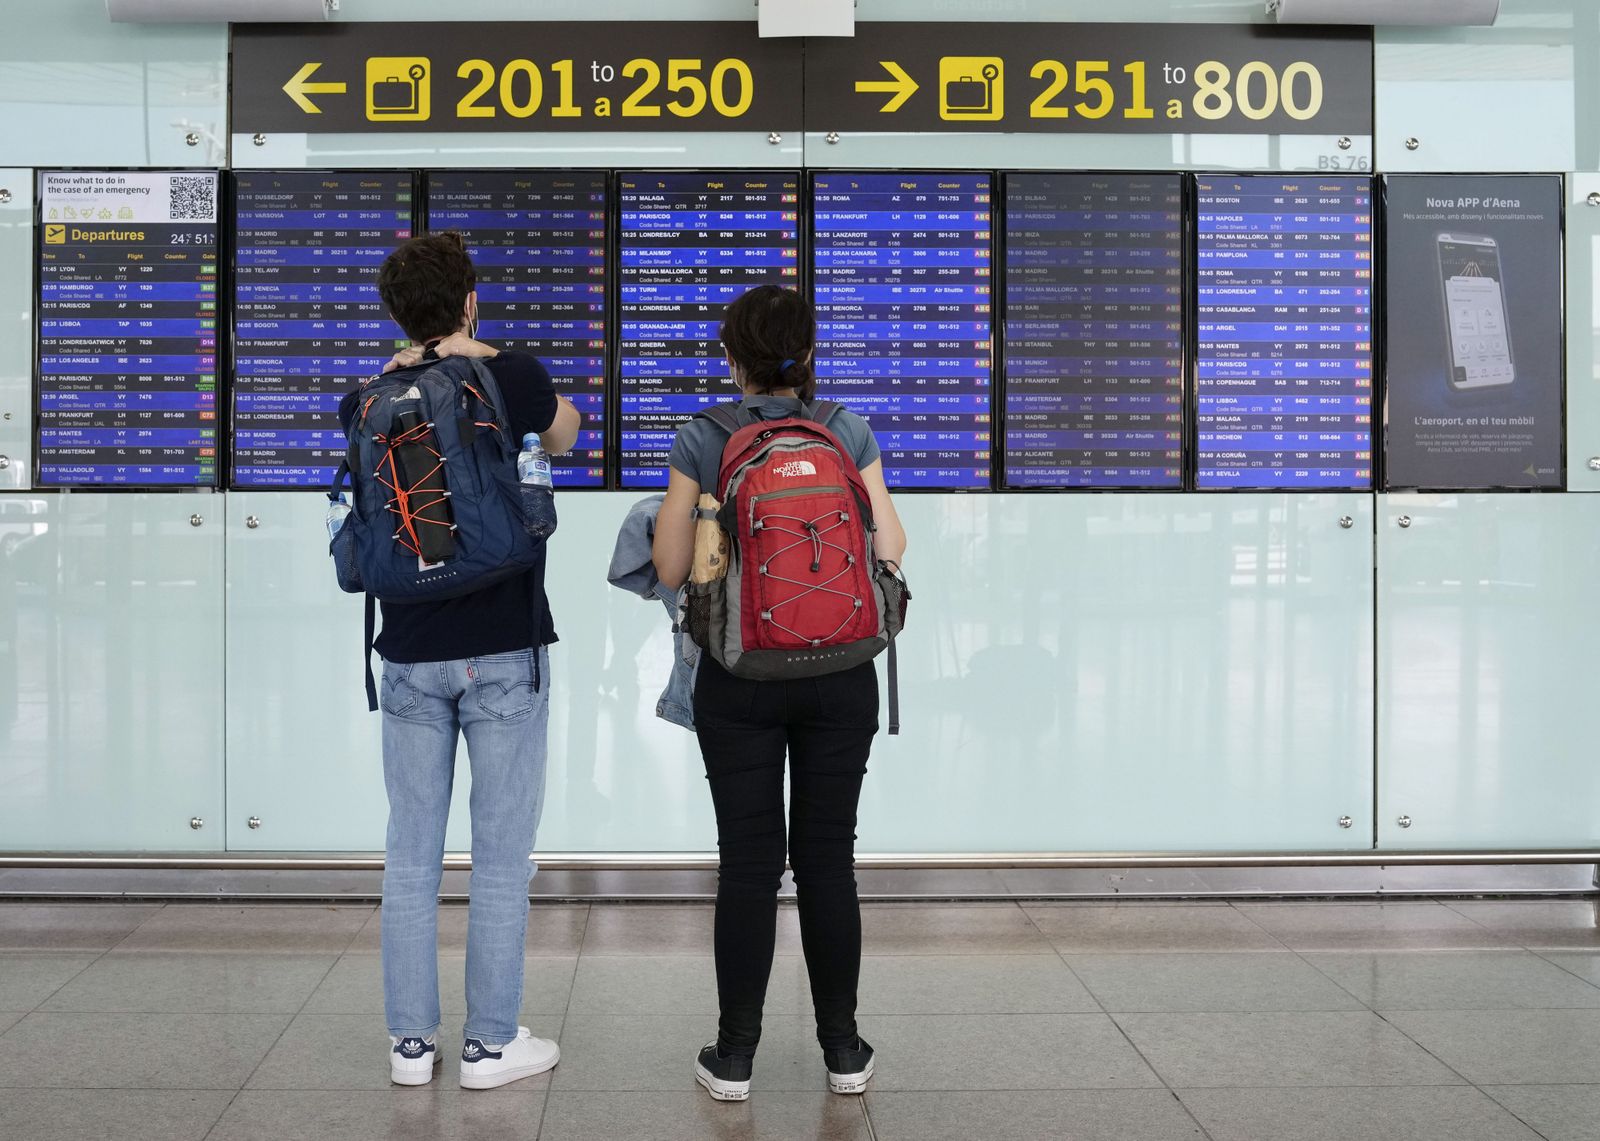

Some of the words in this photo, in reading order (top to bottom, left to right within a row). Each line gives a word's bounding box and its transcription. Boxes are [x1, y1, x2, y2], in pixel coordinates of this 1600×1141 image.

[590, 60, 615, 83] to
[1162, 61, 1186, 85] to
[456, 59, 582, 118] 201
[621, 58, 754, 118] 250
[1029, 59, 1154, 119] 251
[1192, 60, 1323, 120] 800
[594, 96, 611, 117] a
[1166, 98, 1183, 119] a
[1318, 155, 1340, 170] BS
[1346, 156, 1368, 170] 76
[1426, 197, 1454, 208] Nova
[1457, 197, 1480, 208] APP
[1416, 213, 1446, 221] accessible,
[1460, 213, 1482, 221] disseny
[71, 229, 145, 242] Departures
[1480, 416, 1489, 425] el
[1491, 417, 1507, 425] teu
[1509, 416, 1535, 425] mòbil
[773, 466, 800, 475] NORTH
